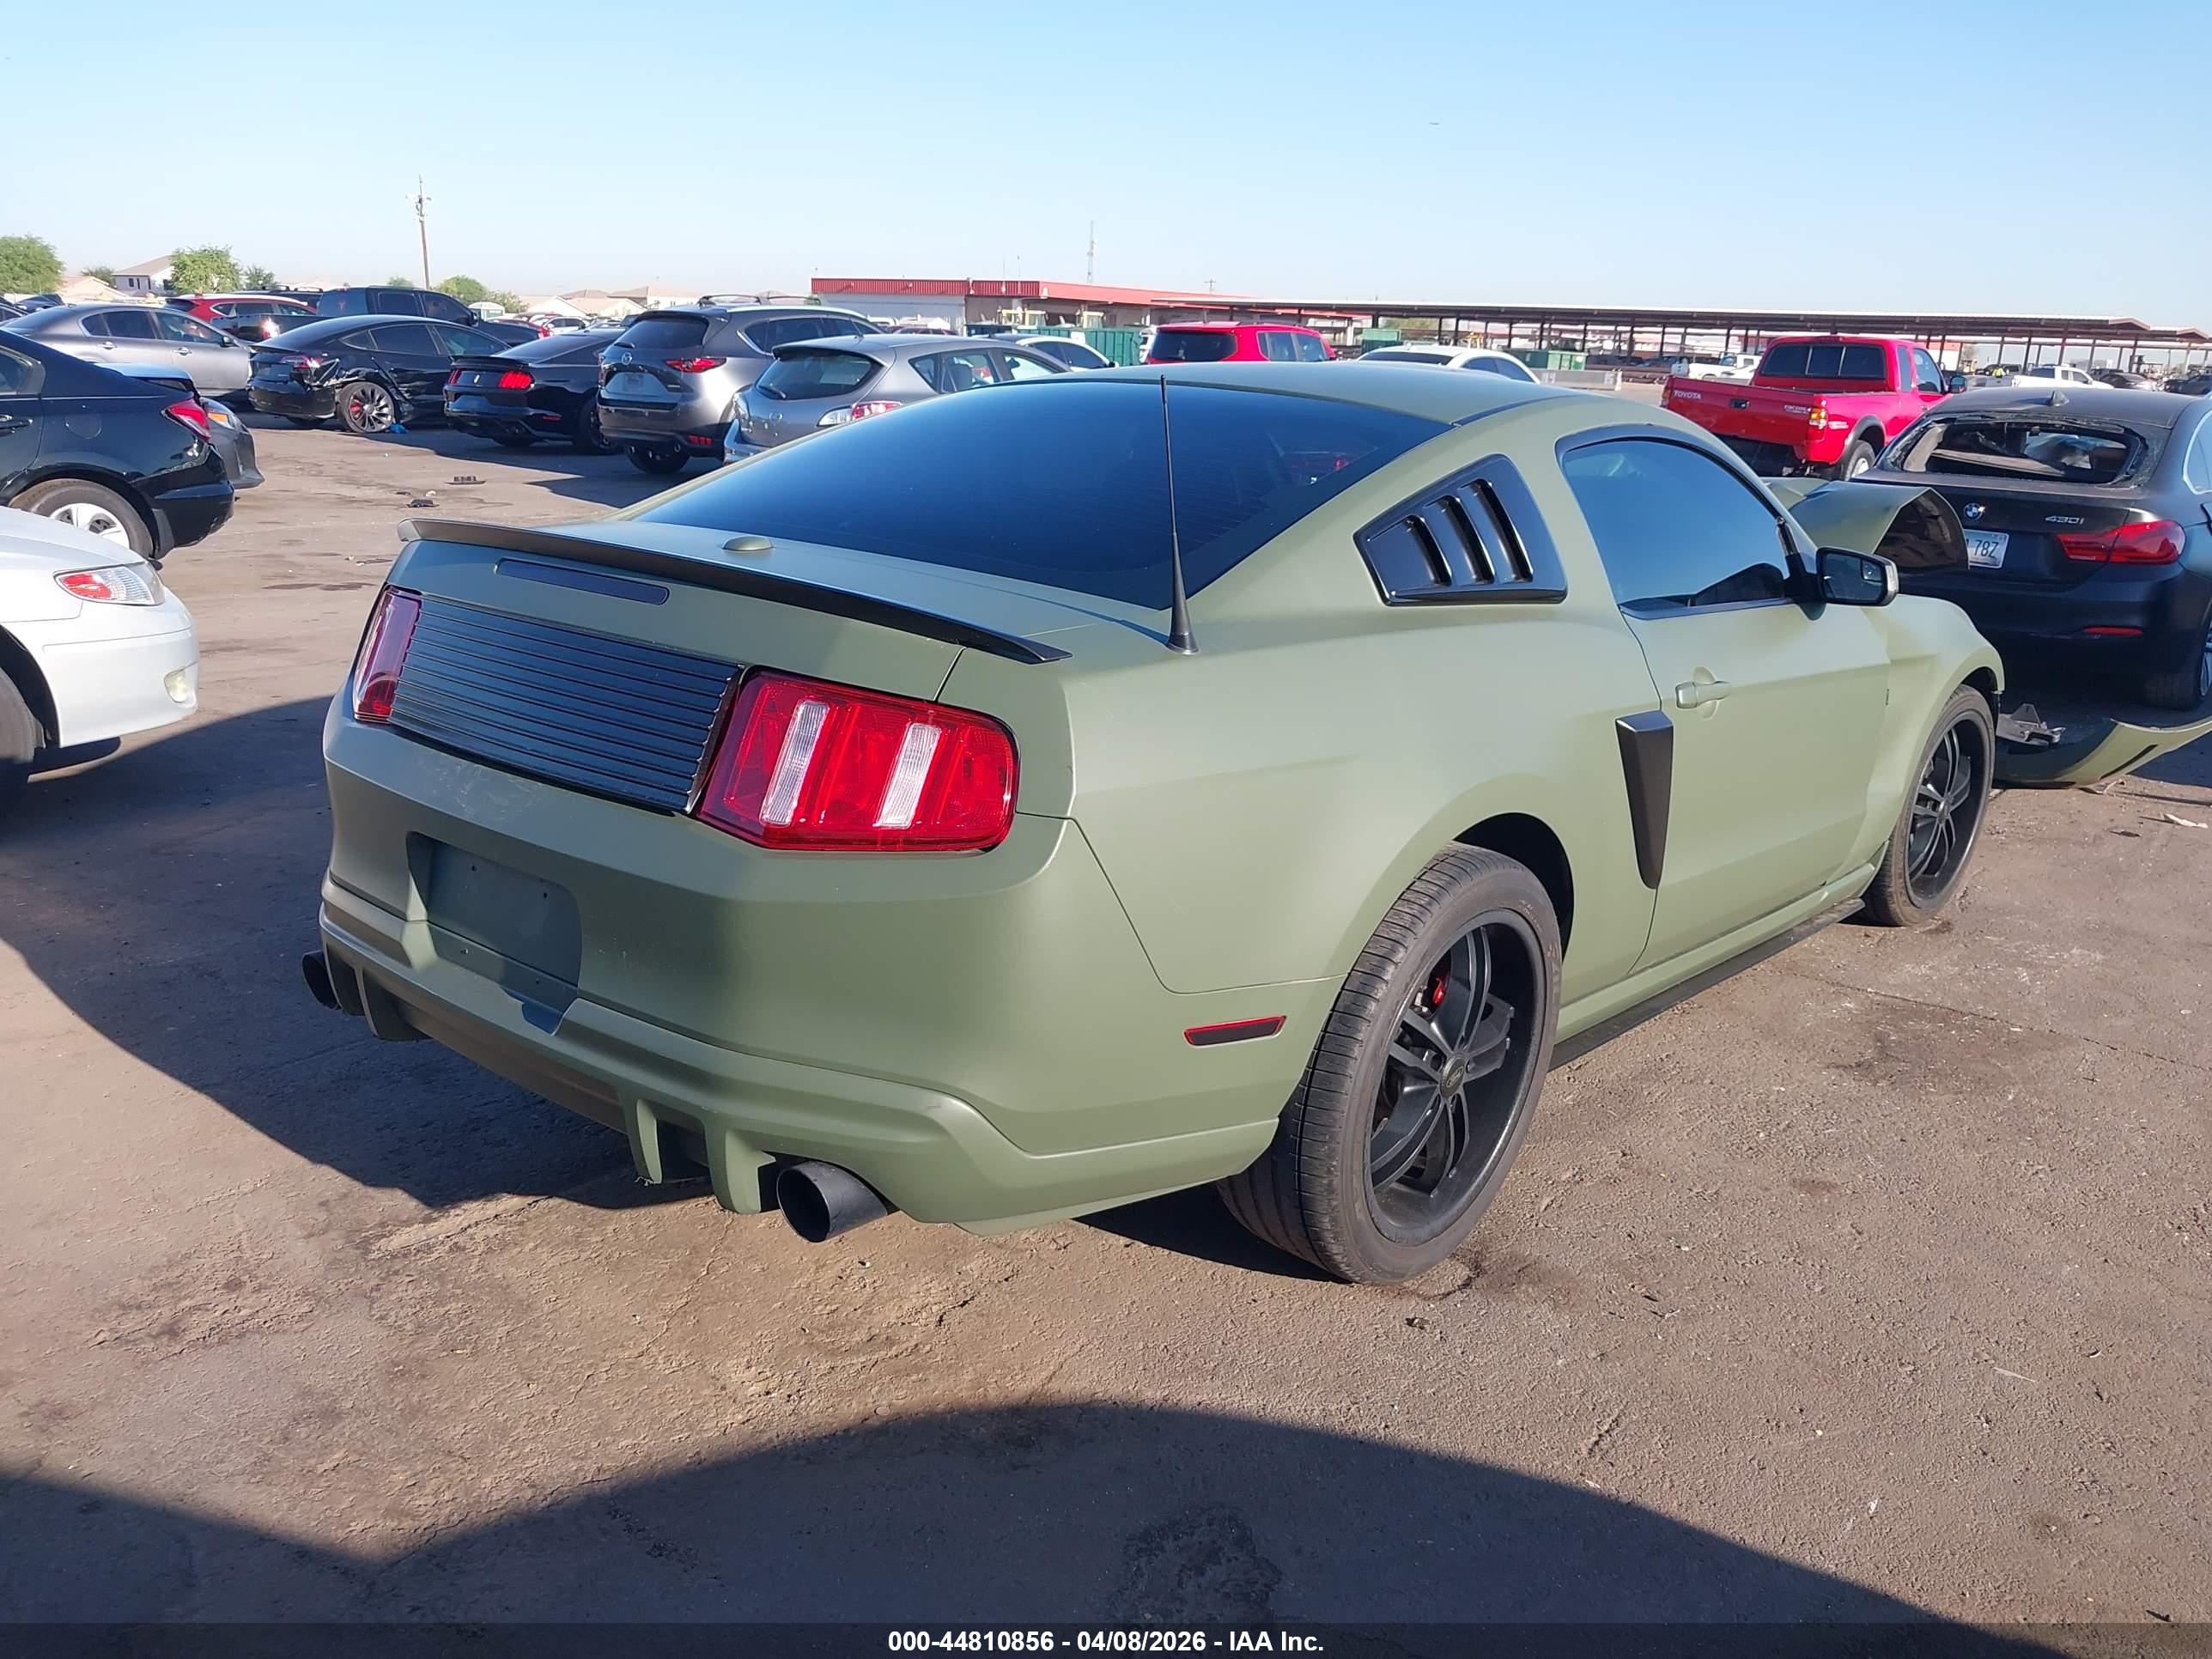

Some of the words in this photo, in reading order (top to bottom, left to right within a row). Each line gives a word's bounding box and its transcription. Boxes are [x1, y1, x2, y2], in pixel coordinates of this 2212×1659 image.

[1673, 390, 1702, 400] TOYOTA
[2045, 515, 2085, 525] 430i
[1974, 539, 1999, 558] 78Z
